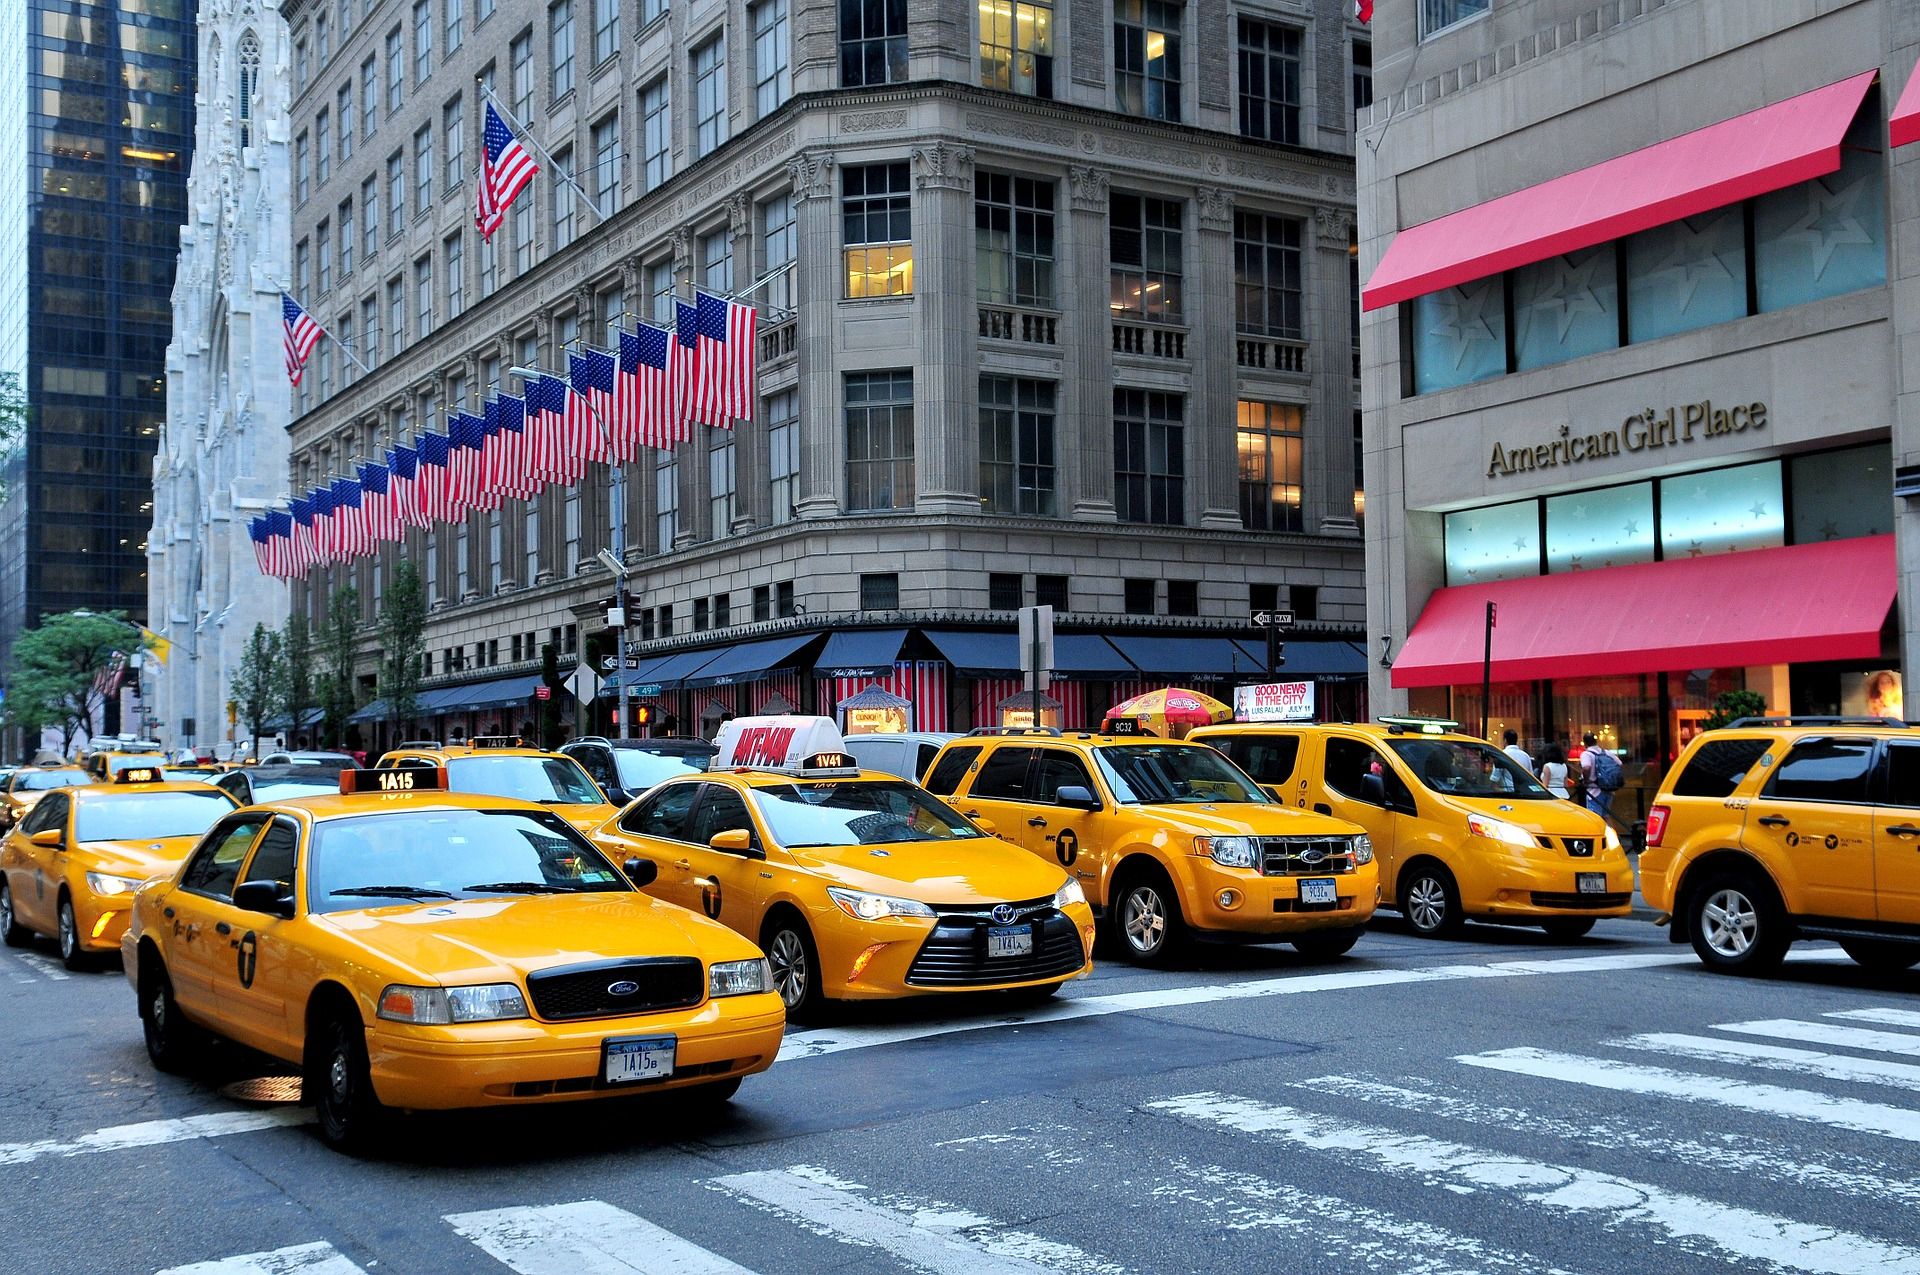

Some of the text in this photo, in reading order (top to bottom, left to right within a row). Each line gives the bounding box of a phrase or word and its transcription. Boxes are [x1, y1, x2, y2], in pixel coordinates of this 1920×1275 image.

[1486, 399, 1768, 478] American Girl Place
[641, 687, 652, 695] 49
[1254, 683, 1307, 697] GOOD NEWS
[1255, 694, 1305, 706] IN THE CITY
[1251, 706, 1264, 715] LUIS
[1264, 705, 1284, 714] PALAU
[1288, 705, 1303, 713] JULY
[1115, 722, 1132, 733] 9C32
[486, 739, 507, 748] 7A12
[816, 754, 842, 768] 1V41
[378, 772, 414, 791] 1A15
